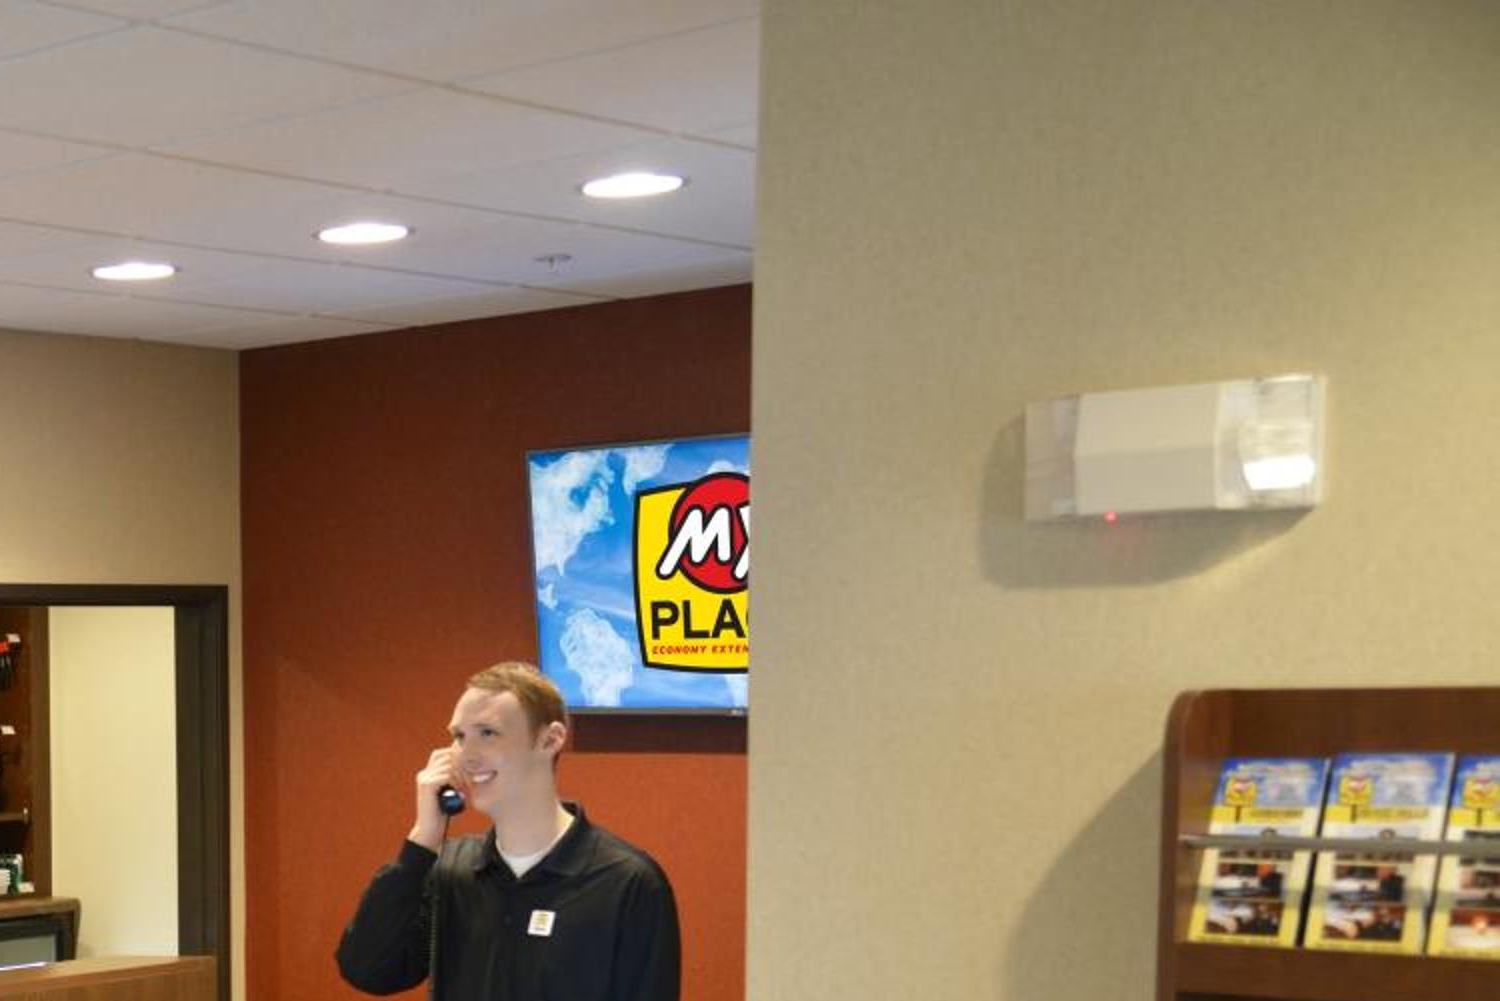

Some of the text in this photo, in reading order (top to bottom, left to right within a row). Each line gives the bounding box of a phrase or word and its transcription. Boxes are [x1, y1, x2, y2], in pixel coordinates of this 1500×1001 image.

[651, 599, 748, 640] PLA
[652, 644, 748, 655] ECONOMY EXTEN
